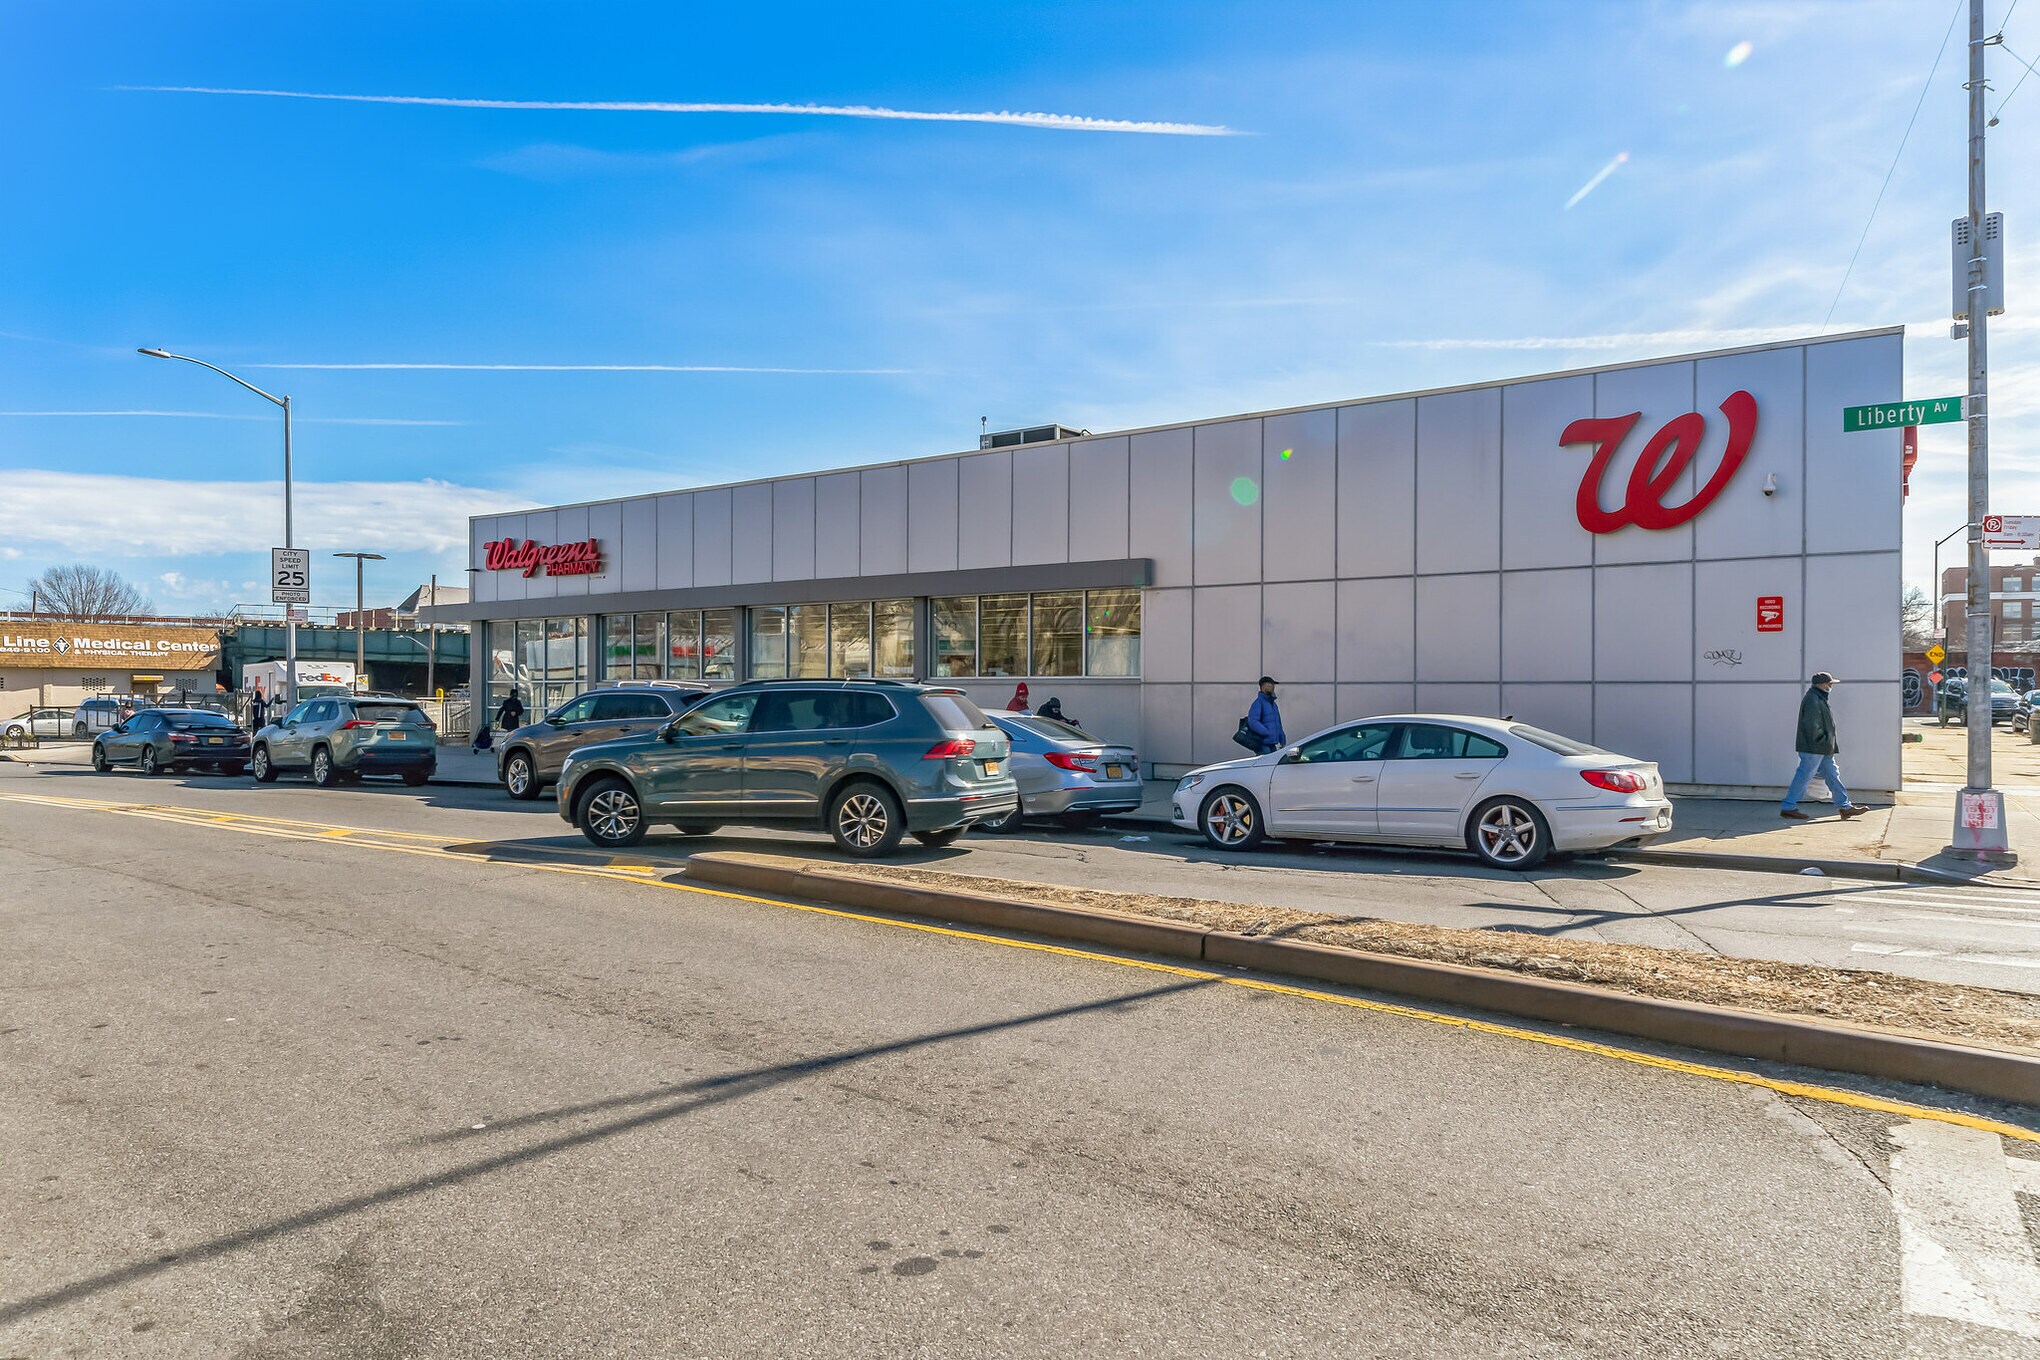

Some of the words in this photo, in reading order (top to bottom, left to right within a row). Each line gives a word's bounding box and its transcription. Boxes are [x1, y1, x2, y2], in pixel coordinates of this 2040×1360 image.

[1858, 404, 1925, 425] Liberty
[1934, 402, 1948, 412] Av
[483, 537, 600, 578] Walgreens
[546, 560, 599, 576] PHARMACY
[278, 571, 305, 586] 25
[3, 635, 50, 648] Line
[73, 637, 150, 651] Medical
[157, 640, 219, 652] Center
[298, 672, 341, 683] FedEx
